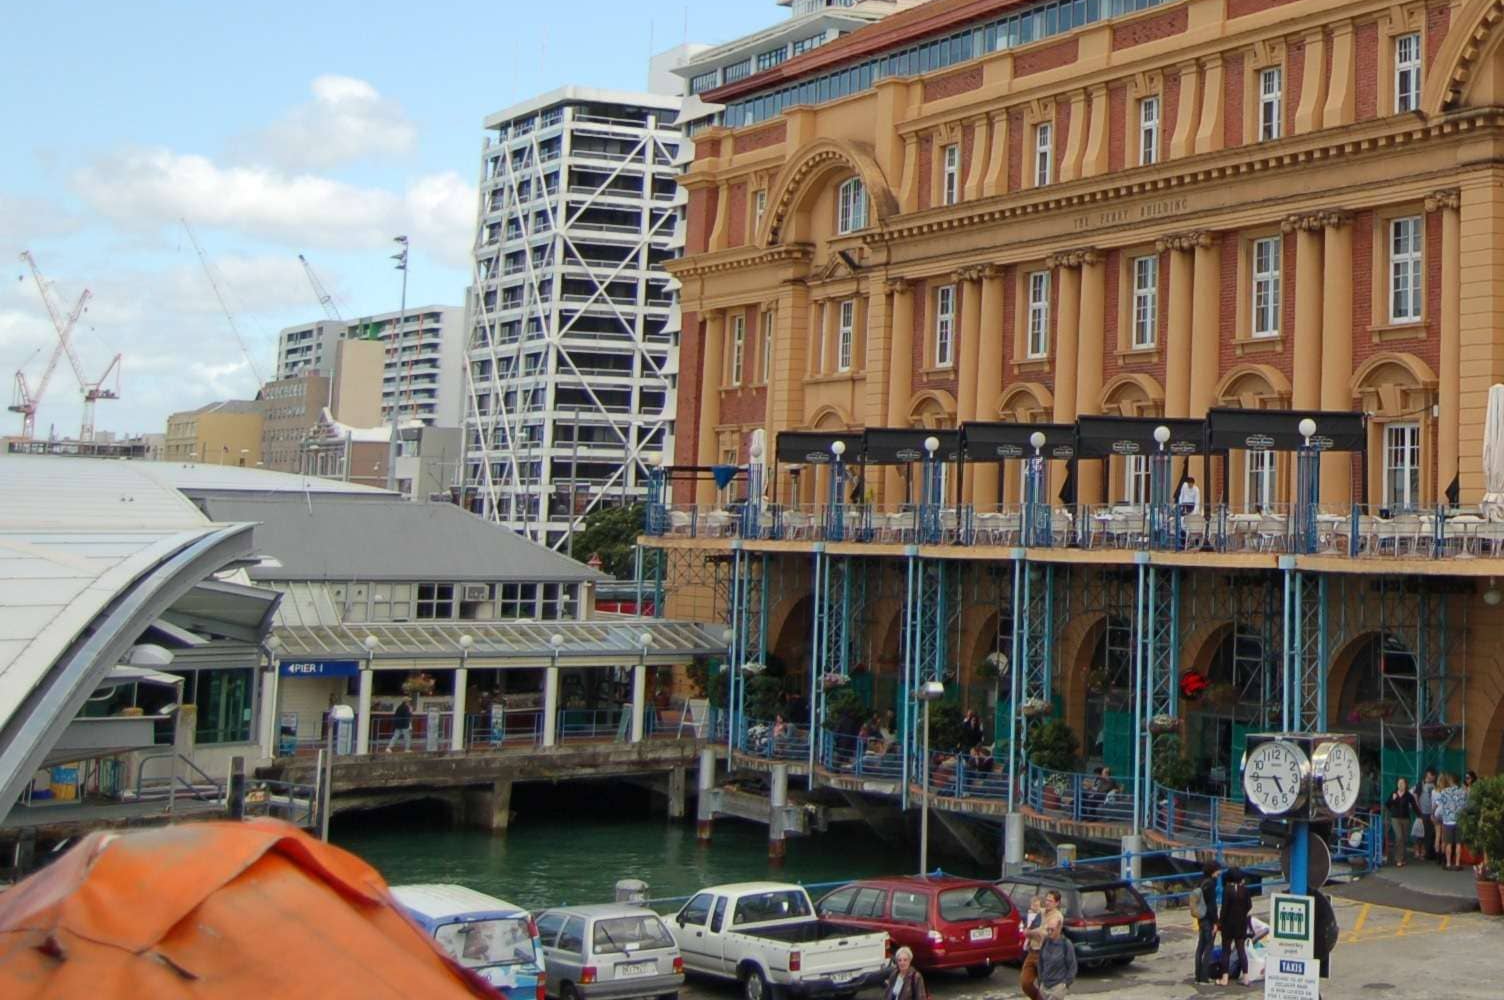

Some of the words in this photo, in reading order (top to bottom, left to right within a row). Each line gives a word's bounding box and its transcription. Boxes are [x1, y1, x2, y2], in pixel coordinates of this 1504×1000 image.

[1100, 209, 1128, 225] FERRY
[1140, 199, 1187, 217] BUILDING
[295, 663, 316, 673] PIER
[1272, 750, 1281, 760] 12
[1254, 760, 1264, 770] 10
[1290, 761, 1296, 771] 2
[1292, 773, 1298, 784] 3
[1256, 782, 1262, 793] 8
[1288, 785, 1295, 794] 4
[1263, 793, 1269, 804] 7
[1272, 796, 1279, 806] 6
[1282, 793, 1288, 803] 5
[1281, 961, 1303, 973] TAXIS
